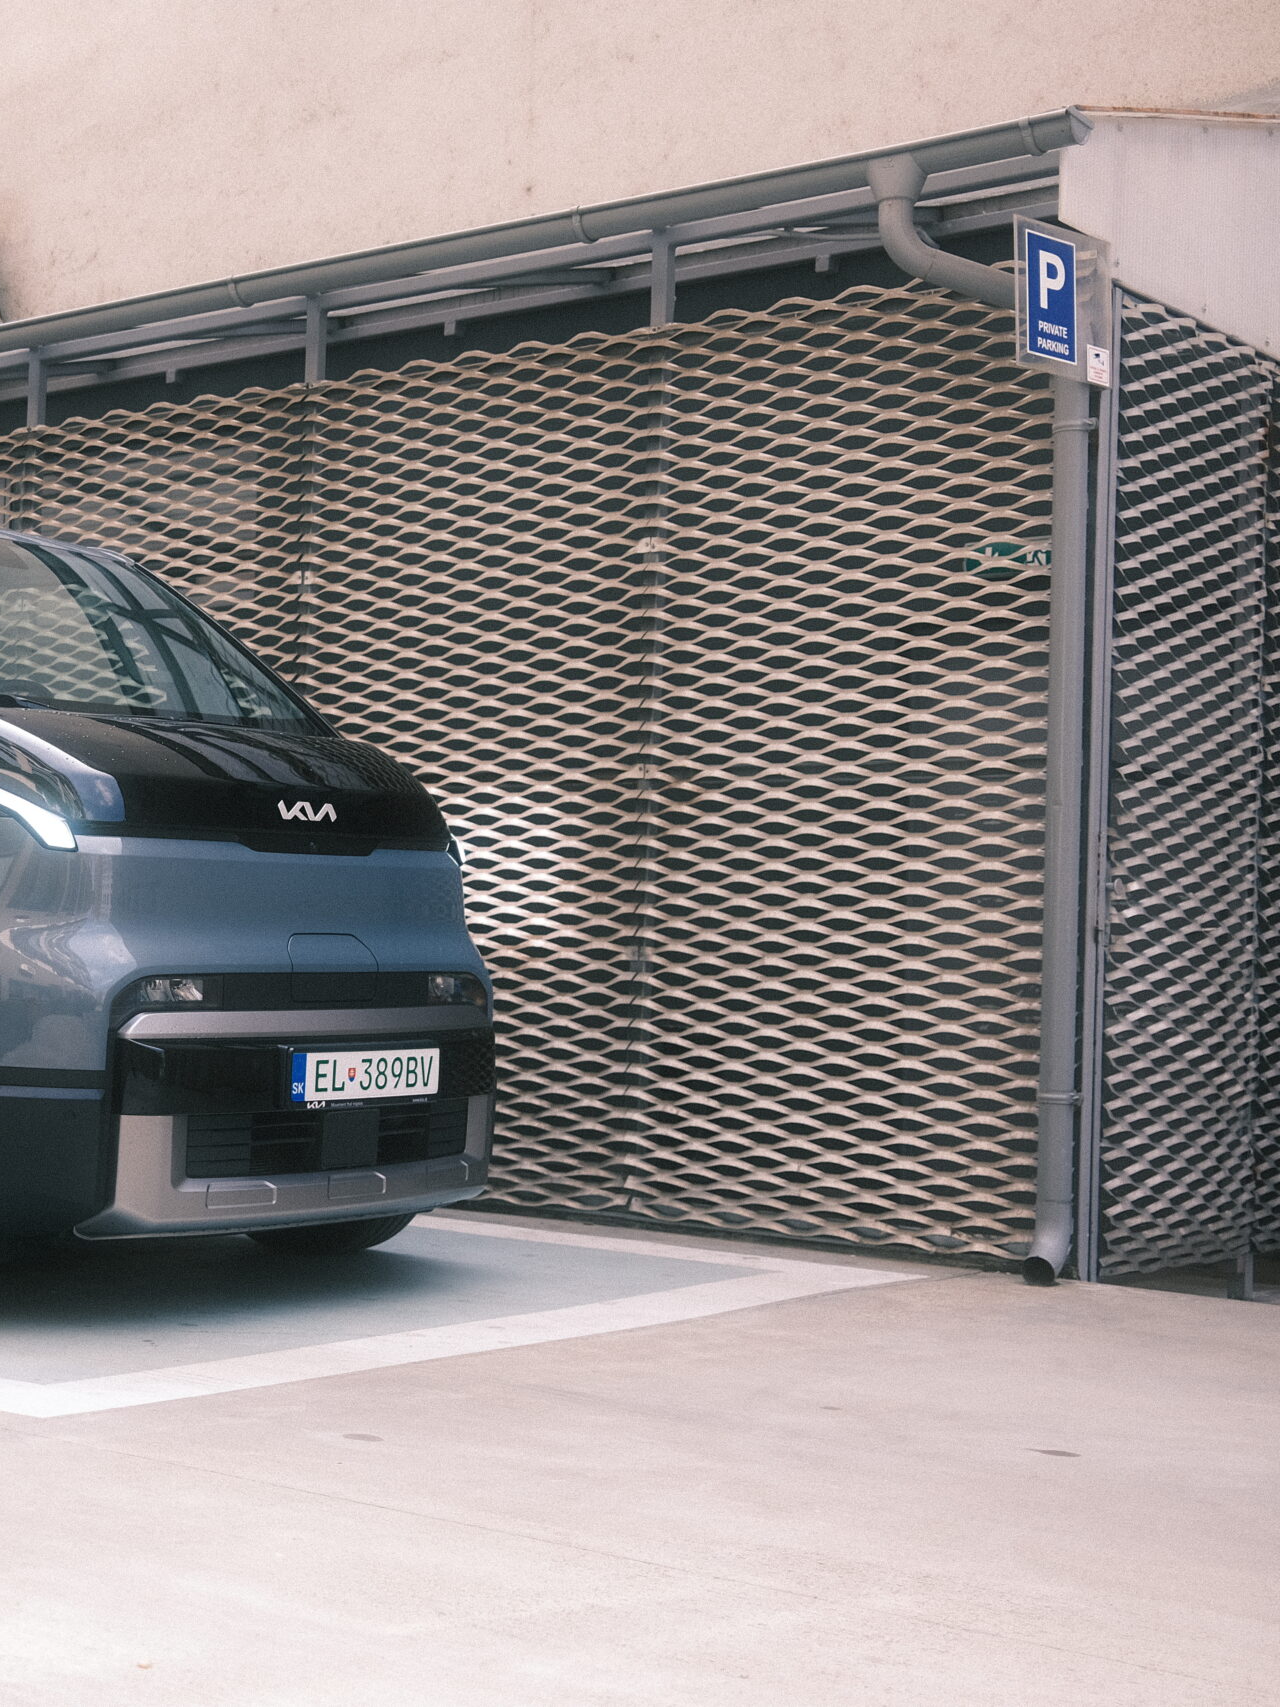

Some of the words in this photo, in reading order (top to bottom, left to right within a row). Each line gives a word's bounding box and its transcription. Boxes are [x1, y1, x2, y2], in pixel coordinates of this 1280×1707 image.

[1038, 249, 1066, 309] P
[1038, 319, 1068, 339] PRIVATE
[1037, 336, 1070, 355] PARKING
[277, 799, 338, 823] KIA
[314, 1059, 346, 1093] EL
[359, 1055, 434, 1091] 389BV
[291, 1082, 305, 1095] SK
